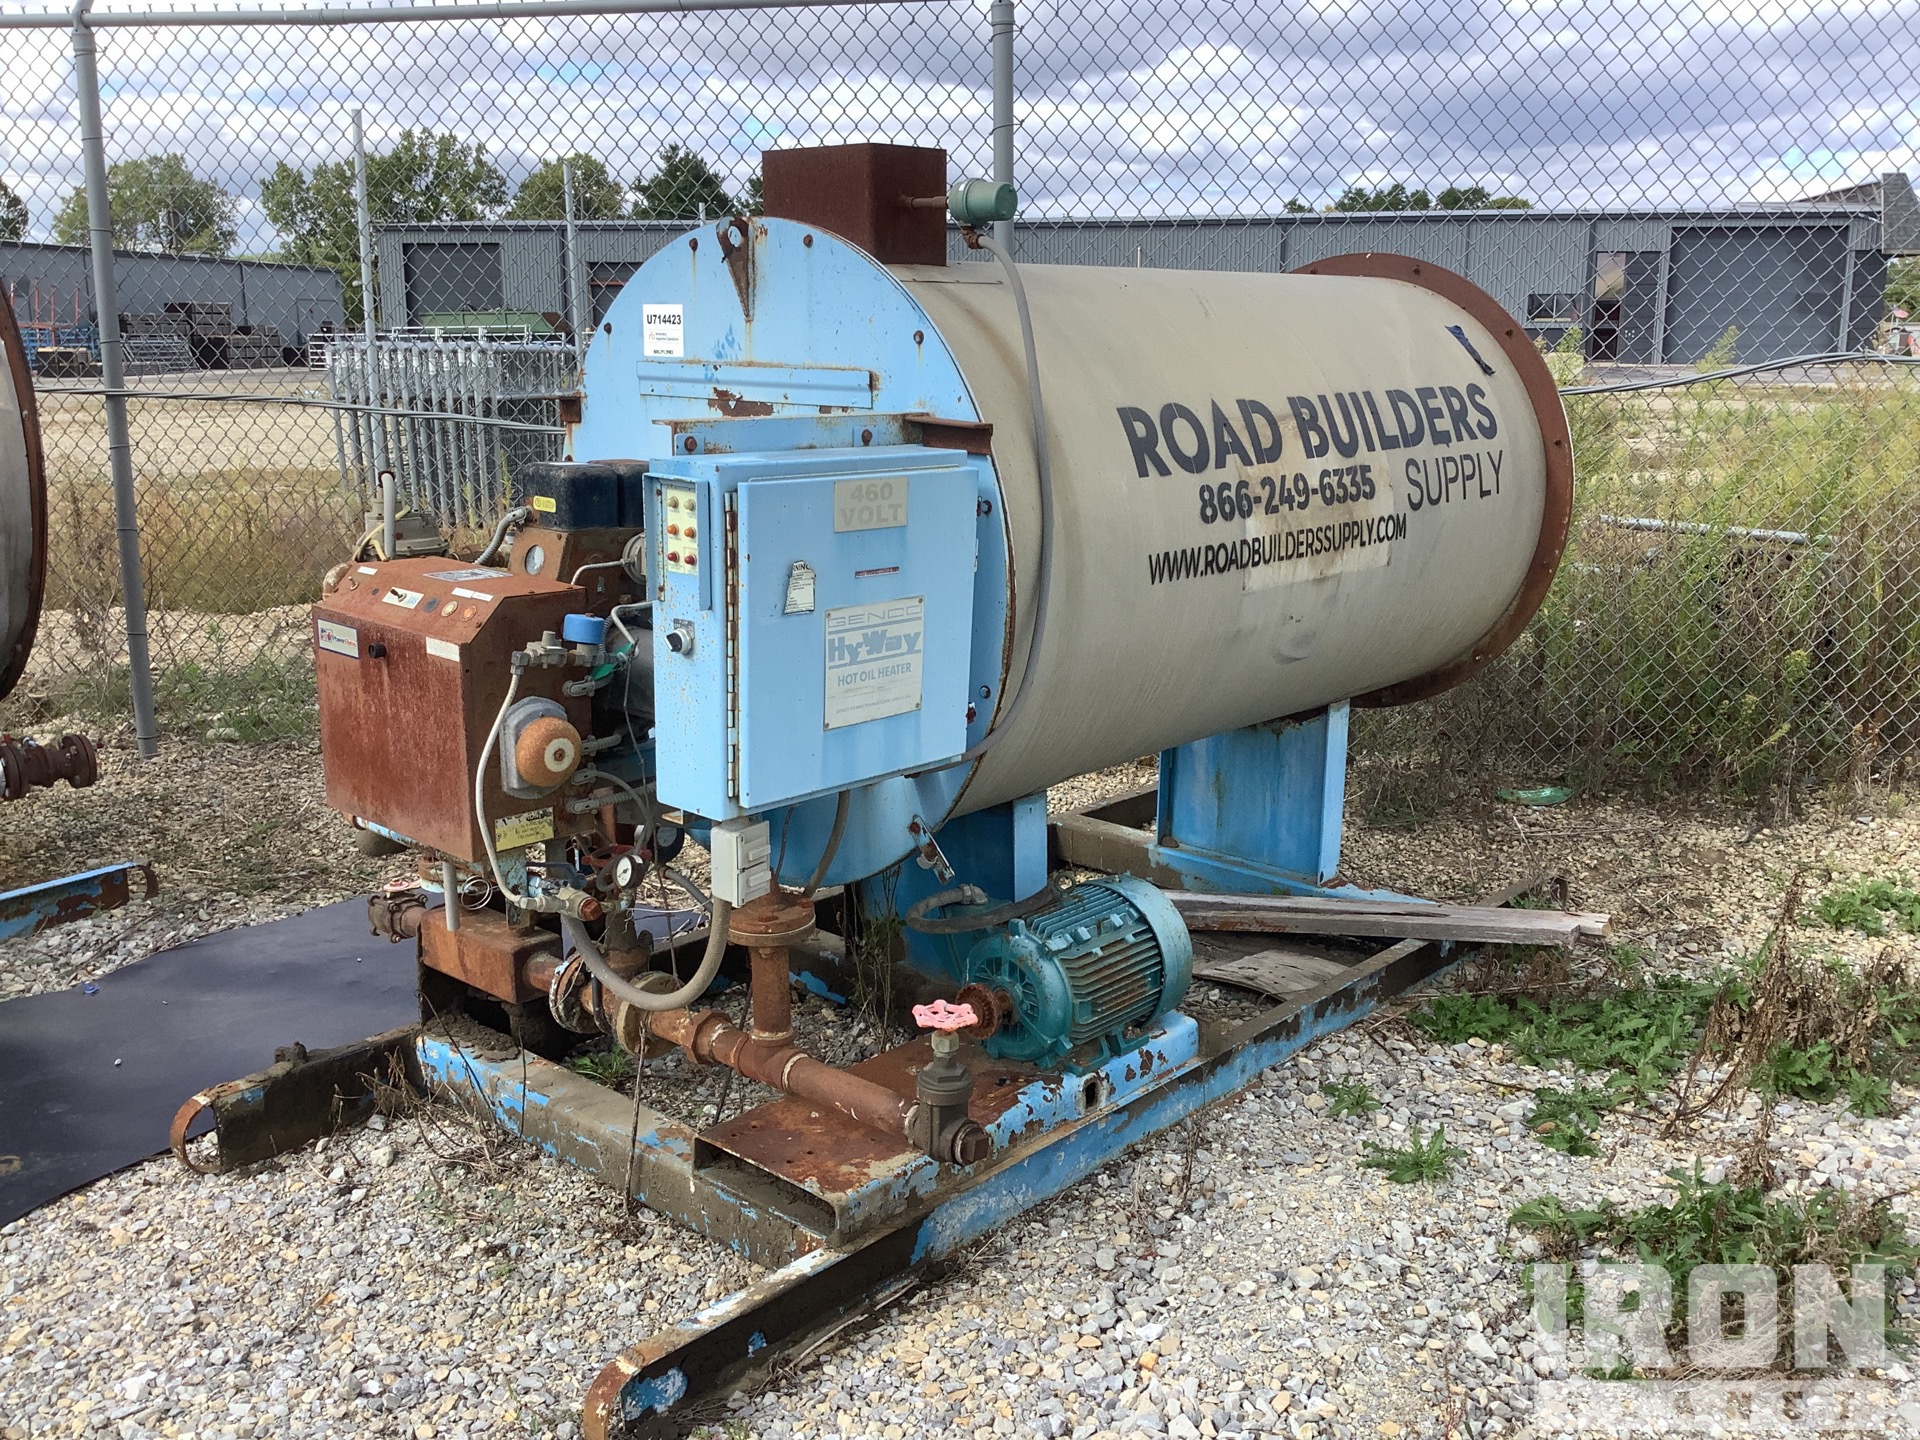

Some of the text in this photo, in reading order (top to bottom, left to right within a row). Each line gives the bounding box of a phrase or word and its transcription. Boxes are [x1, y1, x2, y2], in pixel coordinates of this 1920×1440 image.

[646, 314, 681, 325] U714423
[1116, 383, 1498, 478] ROAD BUILDERS
[850, 482, 893, 502] 460
[1405, 450, 1503, 511] SUPPLY
[1199, 464, 1376, 524] 866-249-6335
[840, 503, 902, 526] VOLT
[1148, 513, 1407, 585] WWW.ROADBUILDERSSUPPLY.COM
[828, 605, 922, 628] GENCO
[838, 662, 911, 686] HOT OIL HEATER
